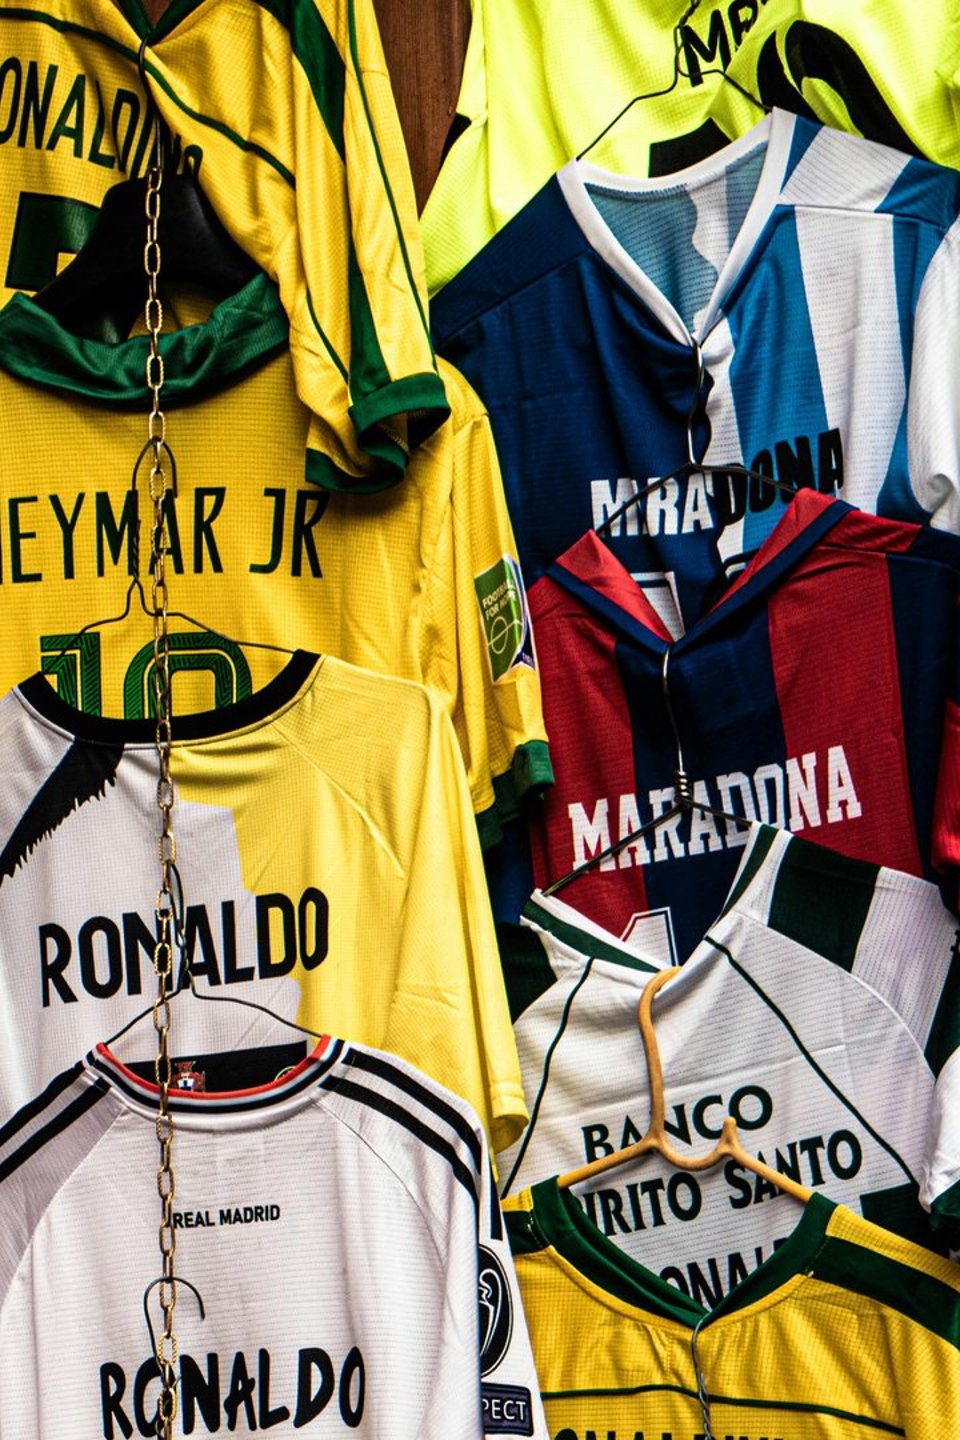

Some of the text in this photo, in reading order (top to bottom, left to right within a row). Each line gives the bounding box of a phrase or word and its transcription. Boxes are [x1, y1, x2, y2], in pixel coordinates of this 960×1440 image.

[249, 488, 331, 578] JR
[568, 745, 862, 874] MARADONA
[41, 886, 329, 1008] RONALDO
[724, 1129, 863, 1210] SANTO
[172, 1203, 281, 1229] REAL MADRID
